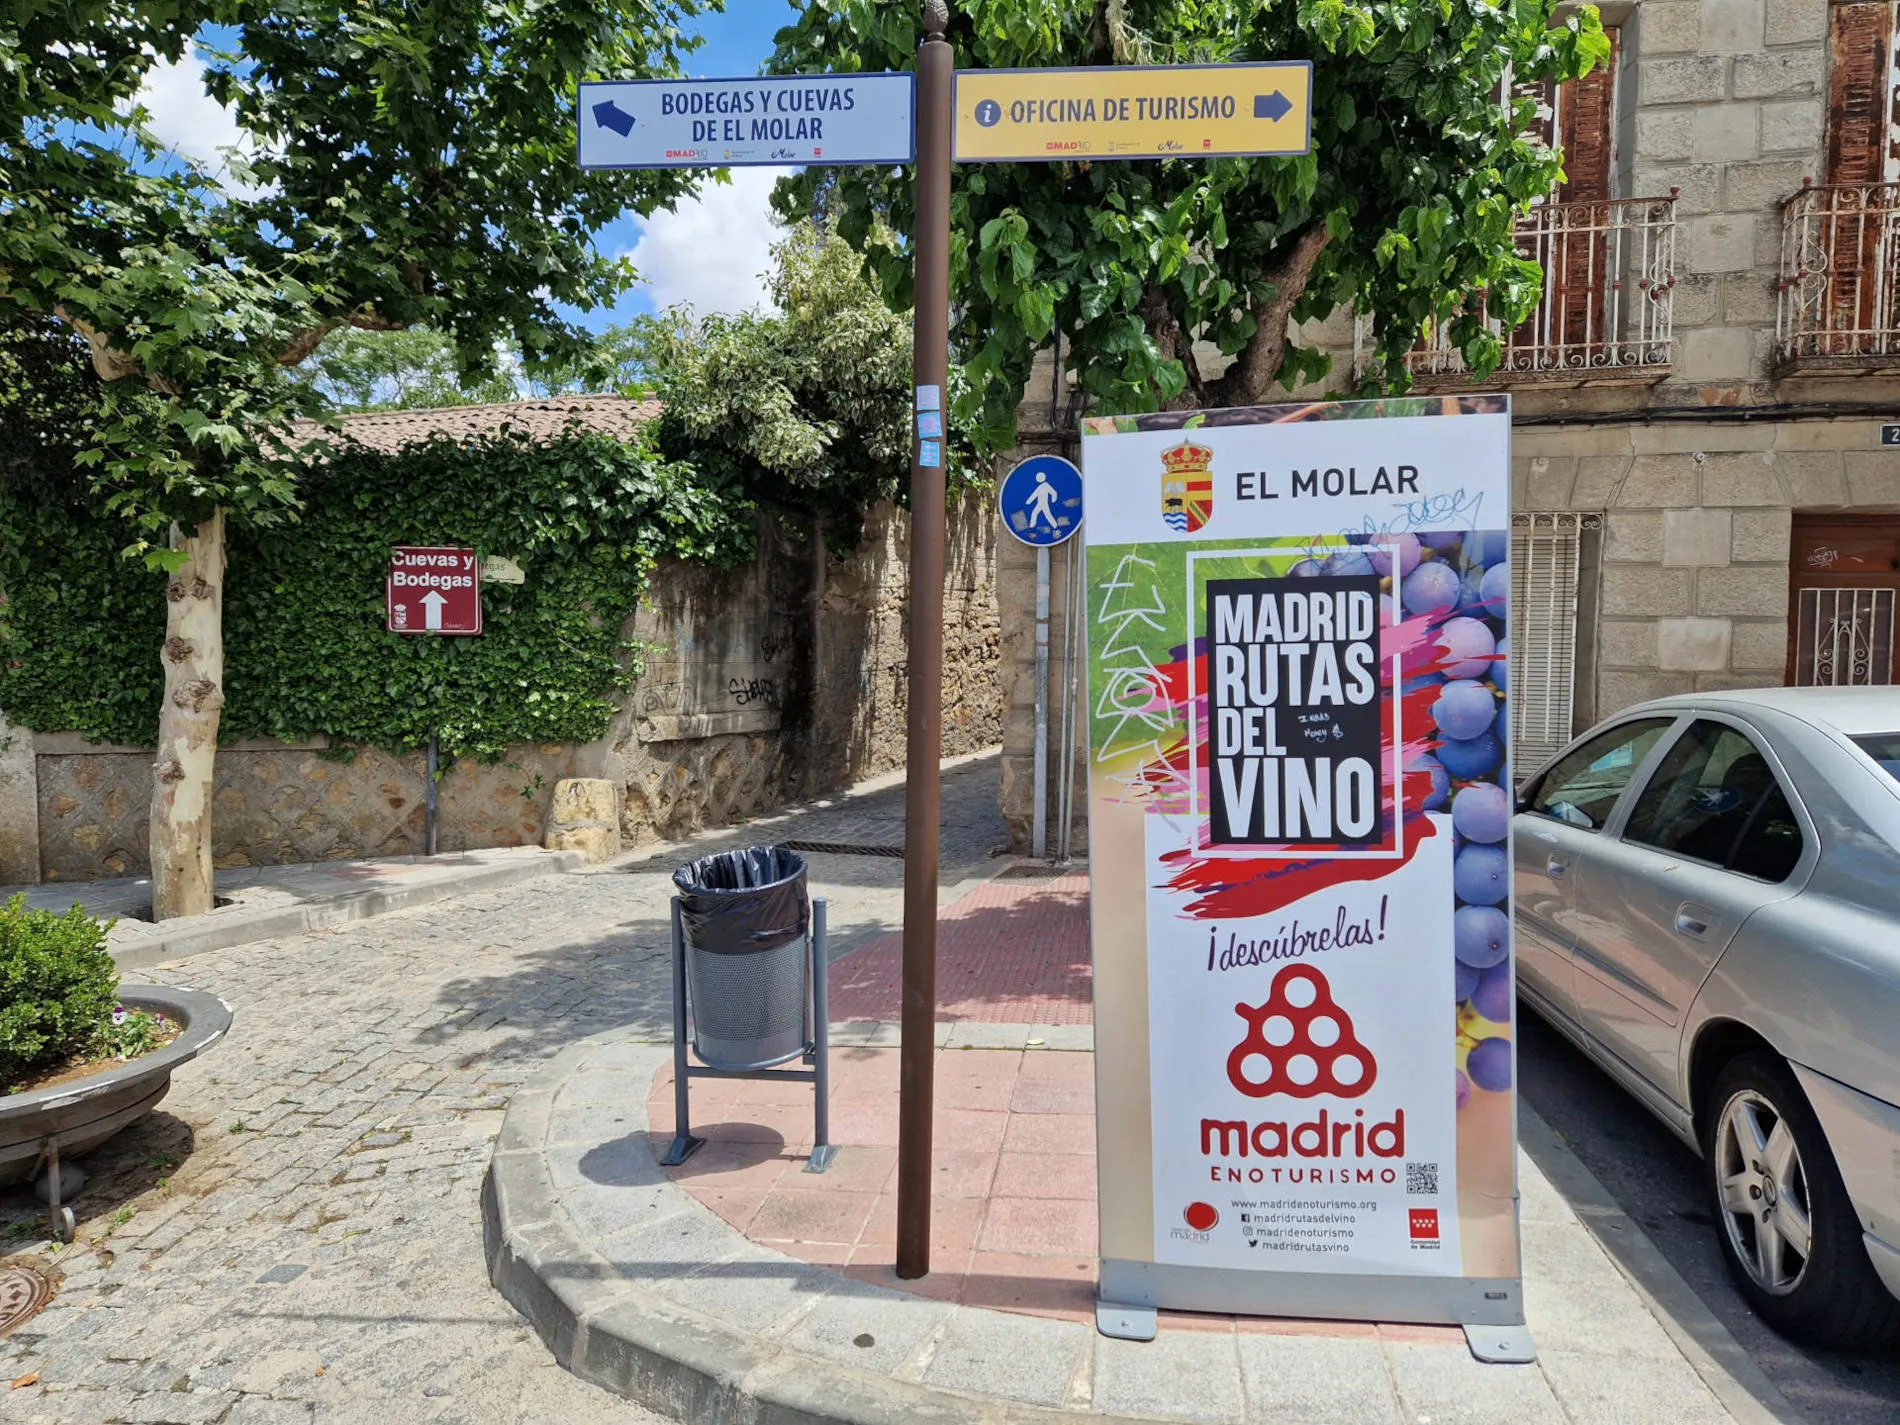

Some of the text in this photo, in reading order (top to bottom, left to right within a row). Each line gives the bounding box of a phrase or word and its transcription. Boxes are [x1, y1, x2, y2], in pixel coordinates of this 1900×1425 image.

[661, 88, 855, 116] BODEGAS Y CUEVAS
[1011, 95, 1235, 124] OFICINA DE TURISMO
[692, 117, 823, 142] DE EL MOLAR
[1236, 465, 1420, 500] EL MOLAR
[391, 551, 474, 571] Cuevas y
[393, 571, 472, 591] Bodegas
[1214, 591, 1374, 643] MADRID
[1215, 641, 1375, 707] RUTAS
[1217, 707, 1288, 756] DEL
[1217, 756, 1375, 839] VINO
[1200, 1108, 1405, 1158] madrid
[1210, 1166, 1396, 1184] ENOTURISMO
[1231, 1199, 1377, 1211] www.madridenoturismo.org
[1254, 1213, 1356, 1224] madridrutasdelvino
[1256, 1227, 1354, 1238] madridenoturismo
[1262, 1240, 1350, 1252] madridrutasvino
